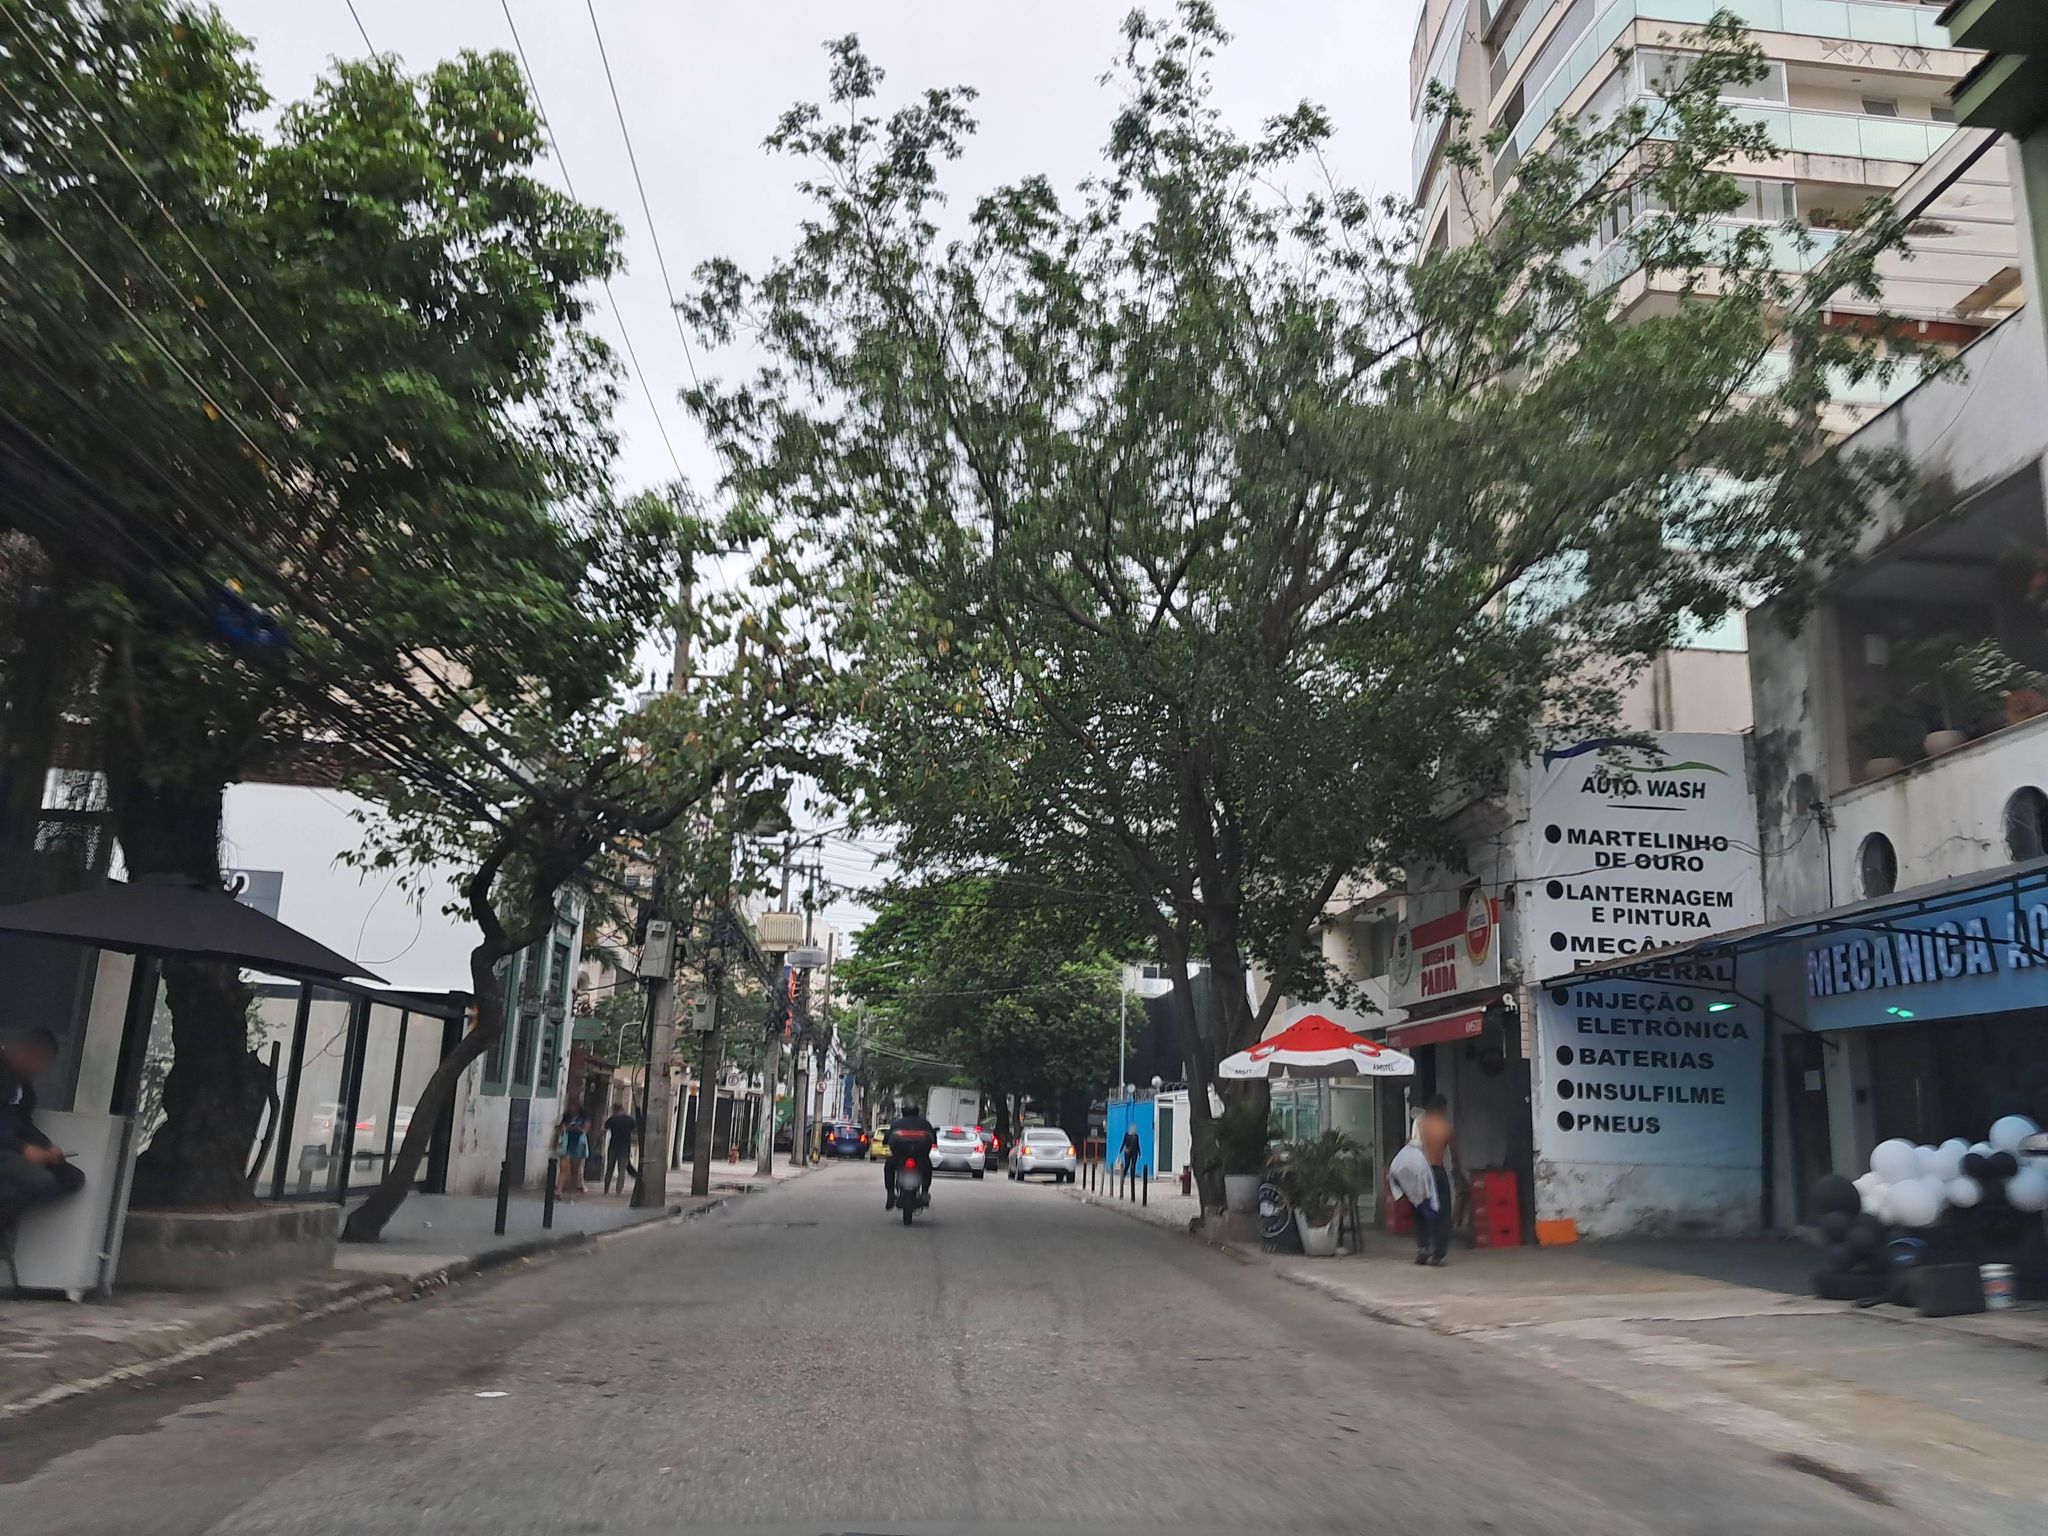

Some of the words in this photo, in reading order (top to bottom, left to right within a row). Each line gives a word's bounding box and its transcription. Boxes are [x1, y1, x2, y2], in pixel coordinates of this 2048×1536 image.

[1581, 777, 1639, 797] AUTO
[1647, 780, 1706, 799] WASH
[1567, 828, 1729, 852] MARTELINHO
[1595, 851, 1627, 868] DE
[1635, 853, 1704, 873] OURO
[1566, 884, 1733, 908] LANTERNAGEM
[1592, 907, 1605, 922] E
[1613, 908, 1712, 928] PINTURA
[1807, 916, 1995, 997] MECANICA
[1576, 990, 1694, 1014] INJEÇÃO
[1577, 1017, 1748, 1040] ELETRÔNICA
[1372, 1063, 1396, 1072] AMSTEL
[1579, 1048, 1714, 1069] BATERIAS
[1577, 1082, 1726, 1105] INSULFILME
[1577, 1114, 1661, 1134] PNEUS
